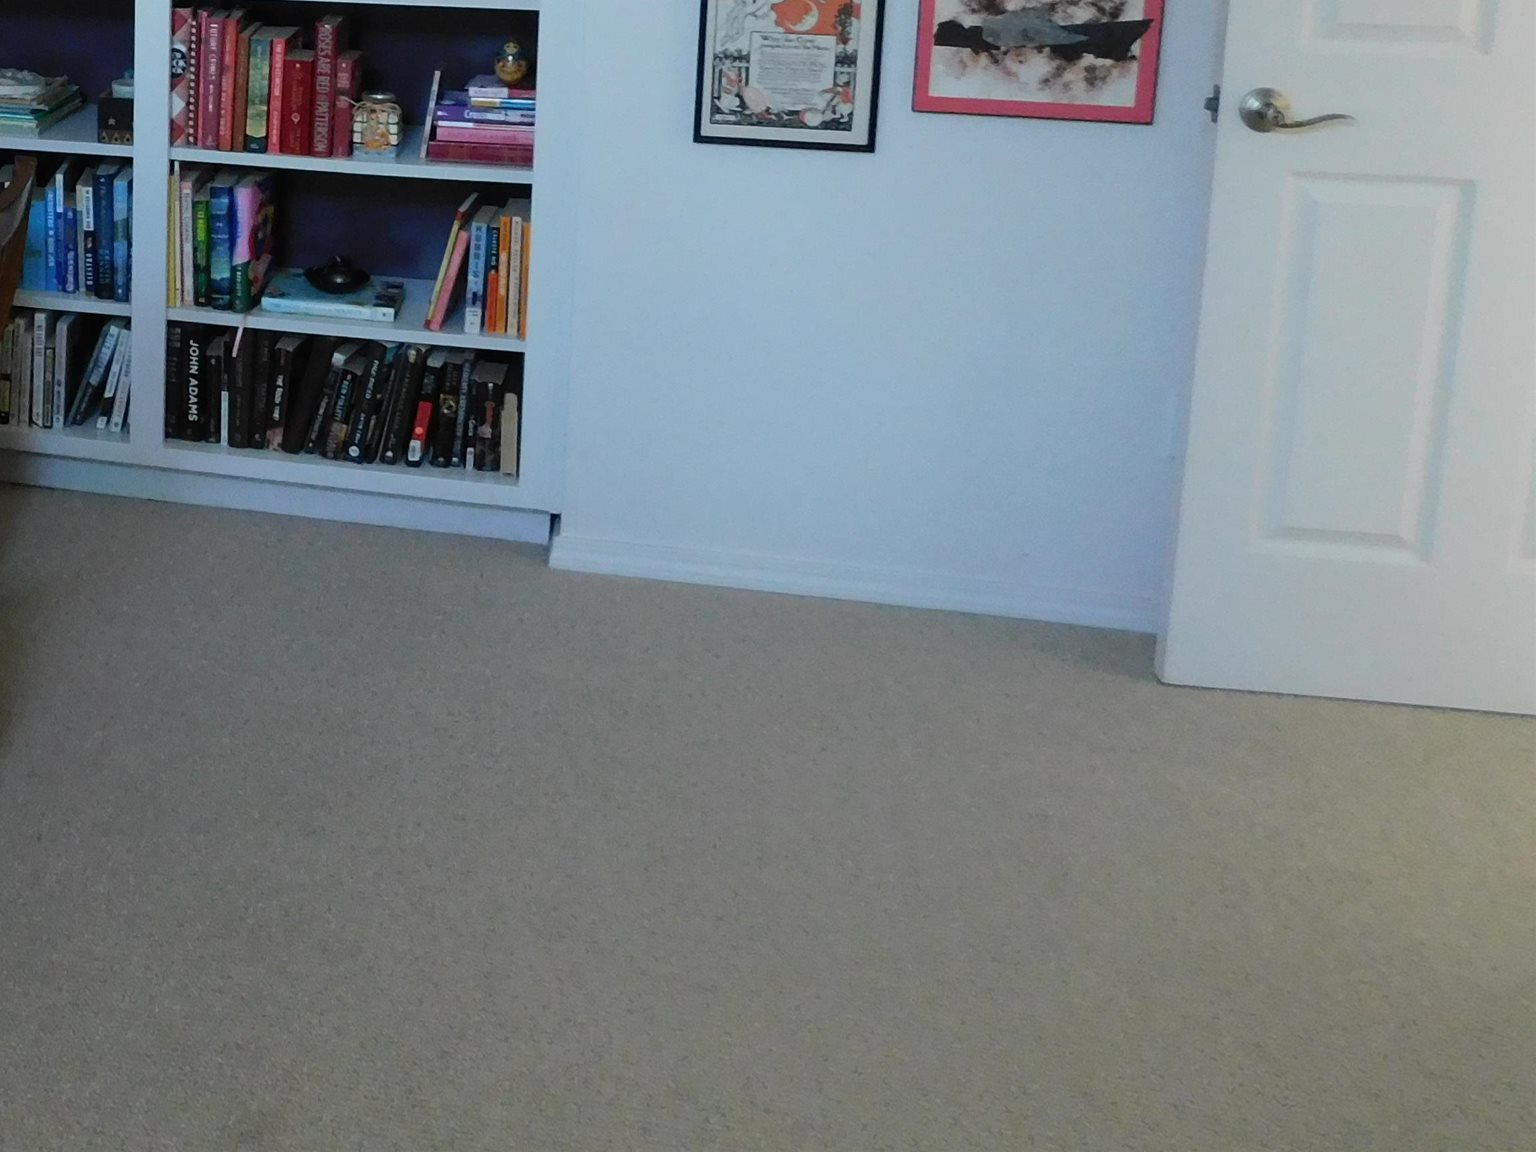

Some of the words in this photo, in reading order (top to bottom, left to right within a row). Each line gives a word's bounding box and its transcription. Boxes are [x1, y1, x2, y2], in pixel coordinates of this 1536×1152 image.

[317, 56, 331, 74] ARE
[316, 75, 331, 93] RED
[313, 101, 330, 152] PATTERSON
[189, 339, 200, 375] JOHN
[187, 377, 199, 422] ADAMS
